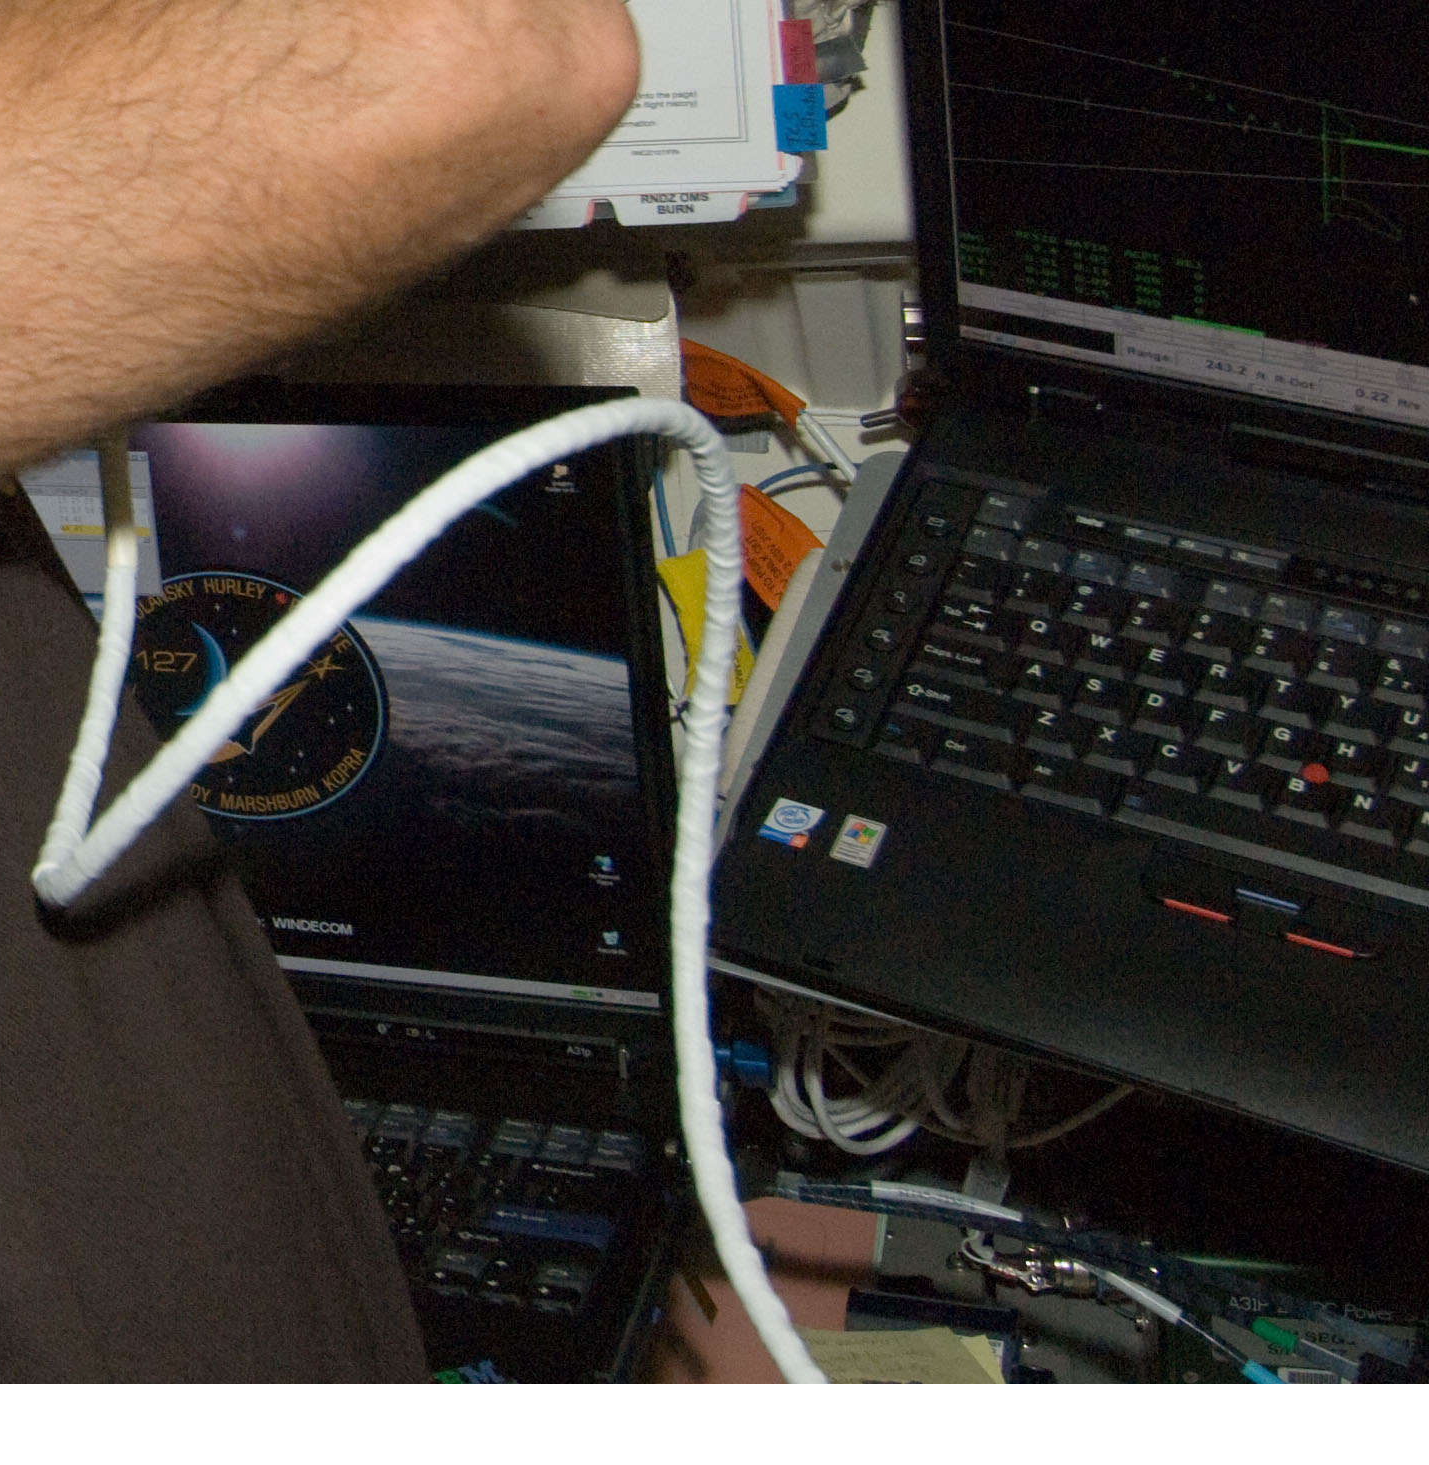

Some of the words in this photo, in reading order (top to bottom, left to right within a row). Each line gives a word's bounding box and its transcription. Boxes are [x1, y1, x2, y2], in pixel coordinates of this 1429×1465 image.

[641, 192, 677, 205] RNDZ
[680, 191, 710, 203] OMS
[657, 204, 695, 215] BURN
[203, 578, 266, 601] HURLEY
[1030, 619, 1048, 634] Q
[1091, 633, 1112, 649] W
[136, 650, 197, 673] 127
[924, 644, 953, 658] Caps
[955, 652, 982, 666] Lock
[1149, 648, 1166, 663] E
[1026, 664, 1044, 678] A
[1210, 664, 1228, 678] R
[1087, 678, 1103, 692] S
[1277, 679, 1291, 693] T
[1147, 694, 1165, 708] D
[1340, 695, 1356, 709] Y
[1038, 711, 1056, 726] Z
[1209, 709, 1226, 723] F
[1403, 711, 1421, 726] U
[1099, 726, 1118, 742] X
[1273, 727, 1291, 741] G
[1161, 744, 1179, 758] C
[1338, 743, 1356, 758] H
[322, 747, 367, 792] KOPRA
[1226, 760, 1243, 774] V
[1289, 778, 1307, 792] B
[220, 785, 320, 813] MARSHBURN
[1354, 794, 1374, 810] N
[272, 917, 353, 936] WINDECOM
